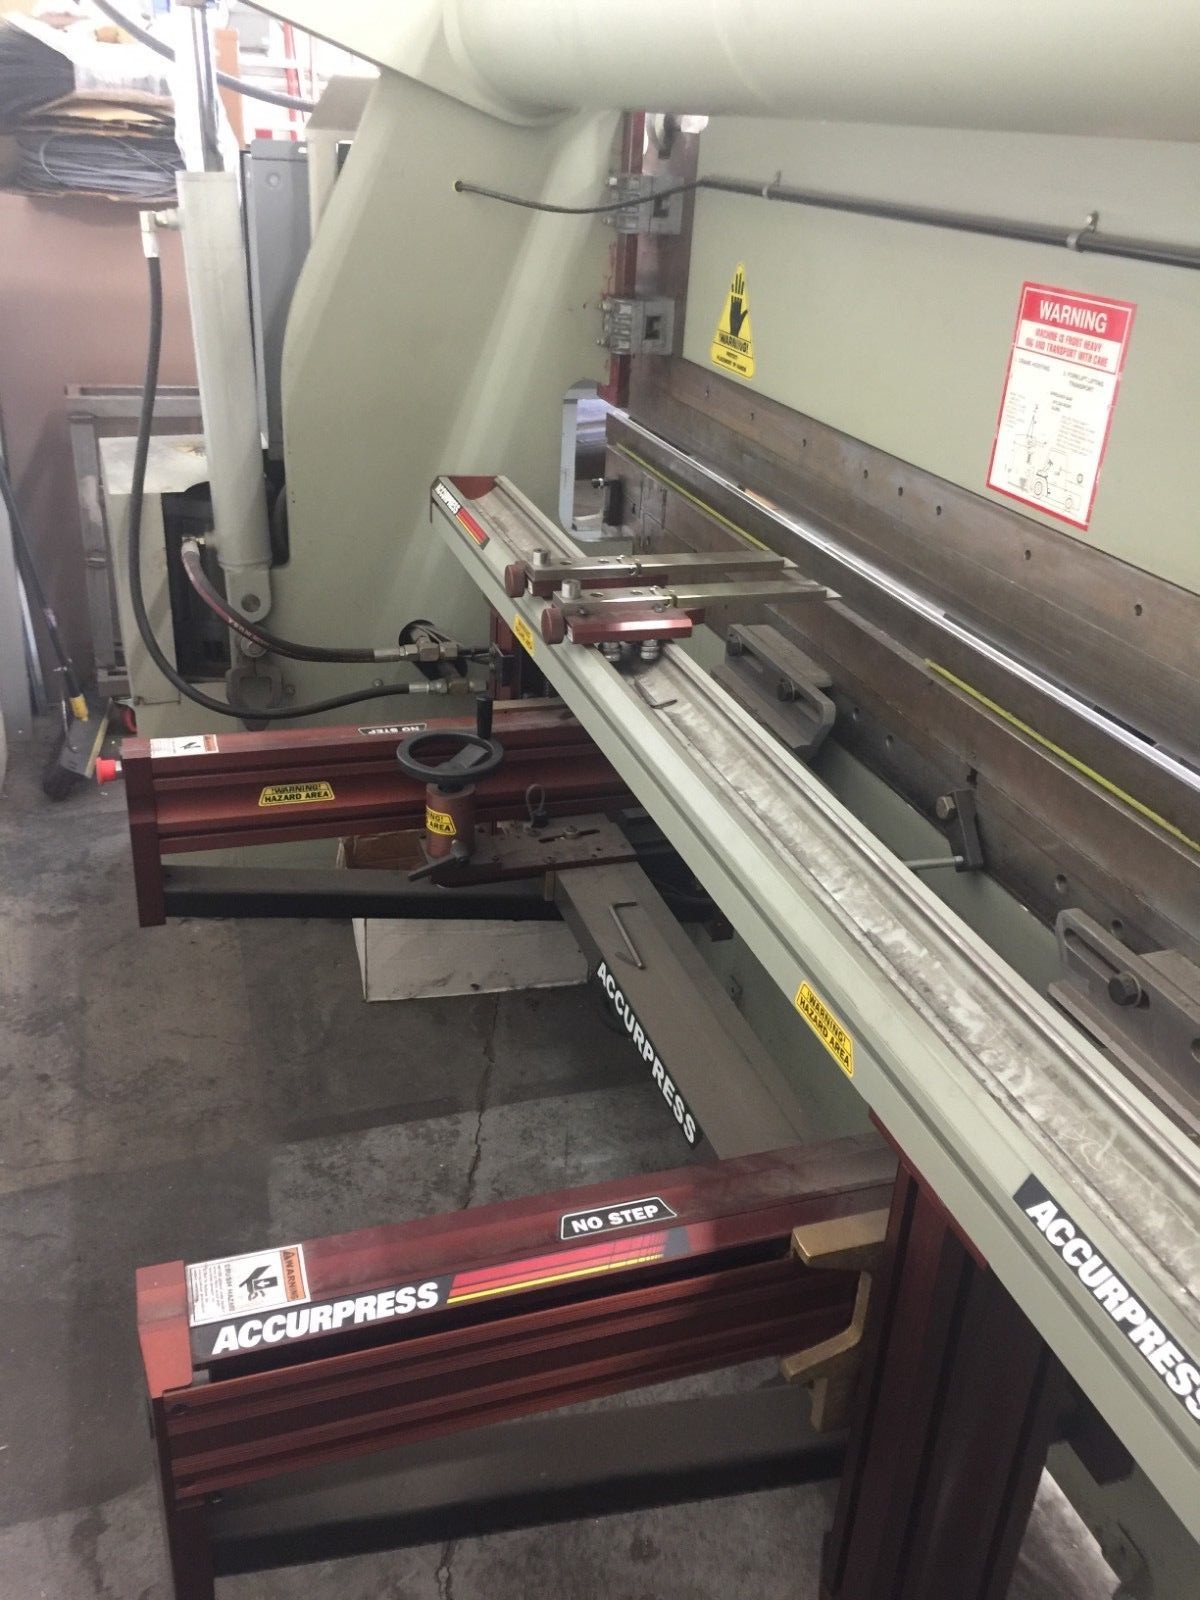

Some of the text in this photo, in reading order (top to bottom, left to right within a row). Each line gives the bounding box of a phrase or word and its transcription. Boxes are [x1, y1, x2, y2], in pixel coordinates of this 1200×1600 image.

[1040, 300, 1108, 333] WARNING
[264, 790, 329, 803] HAZARD AREA
[799, 996, 849, 1067] HAZARD AREA
[597, 962, 696, 1144] ACCURPRESS
[571, 1204, 659, 1233] NO STEP
[285, 1262, 300, 1300] WARNING
[211, 1281, 439, 1355] ACCURPRESS
